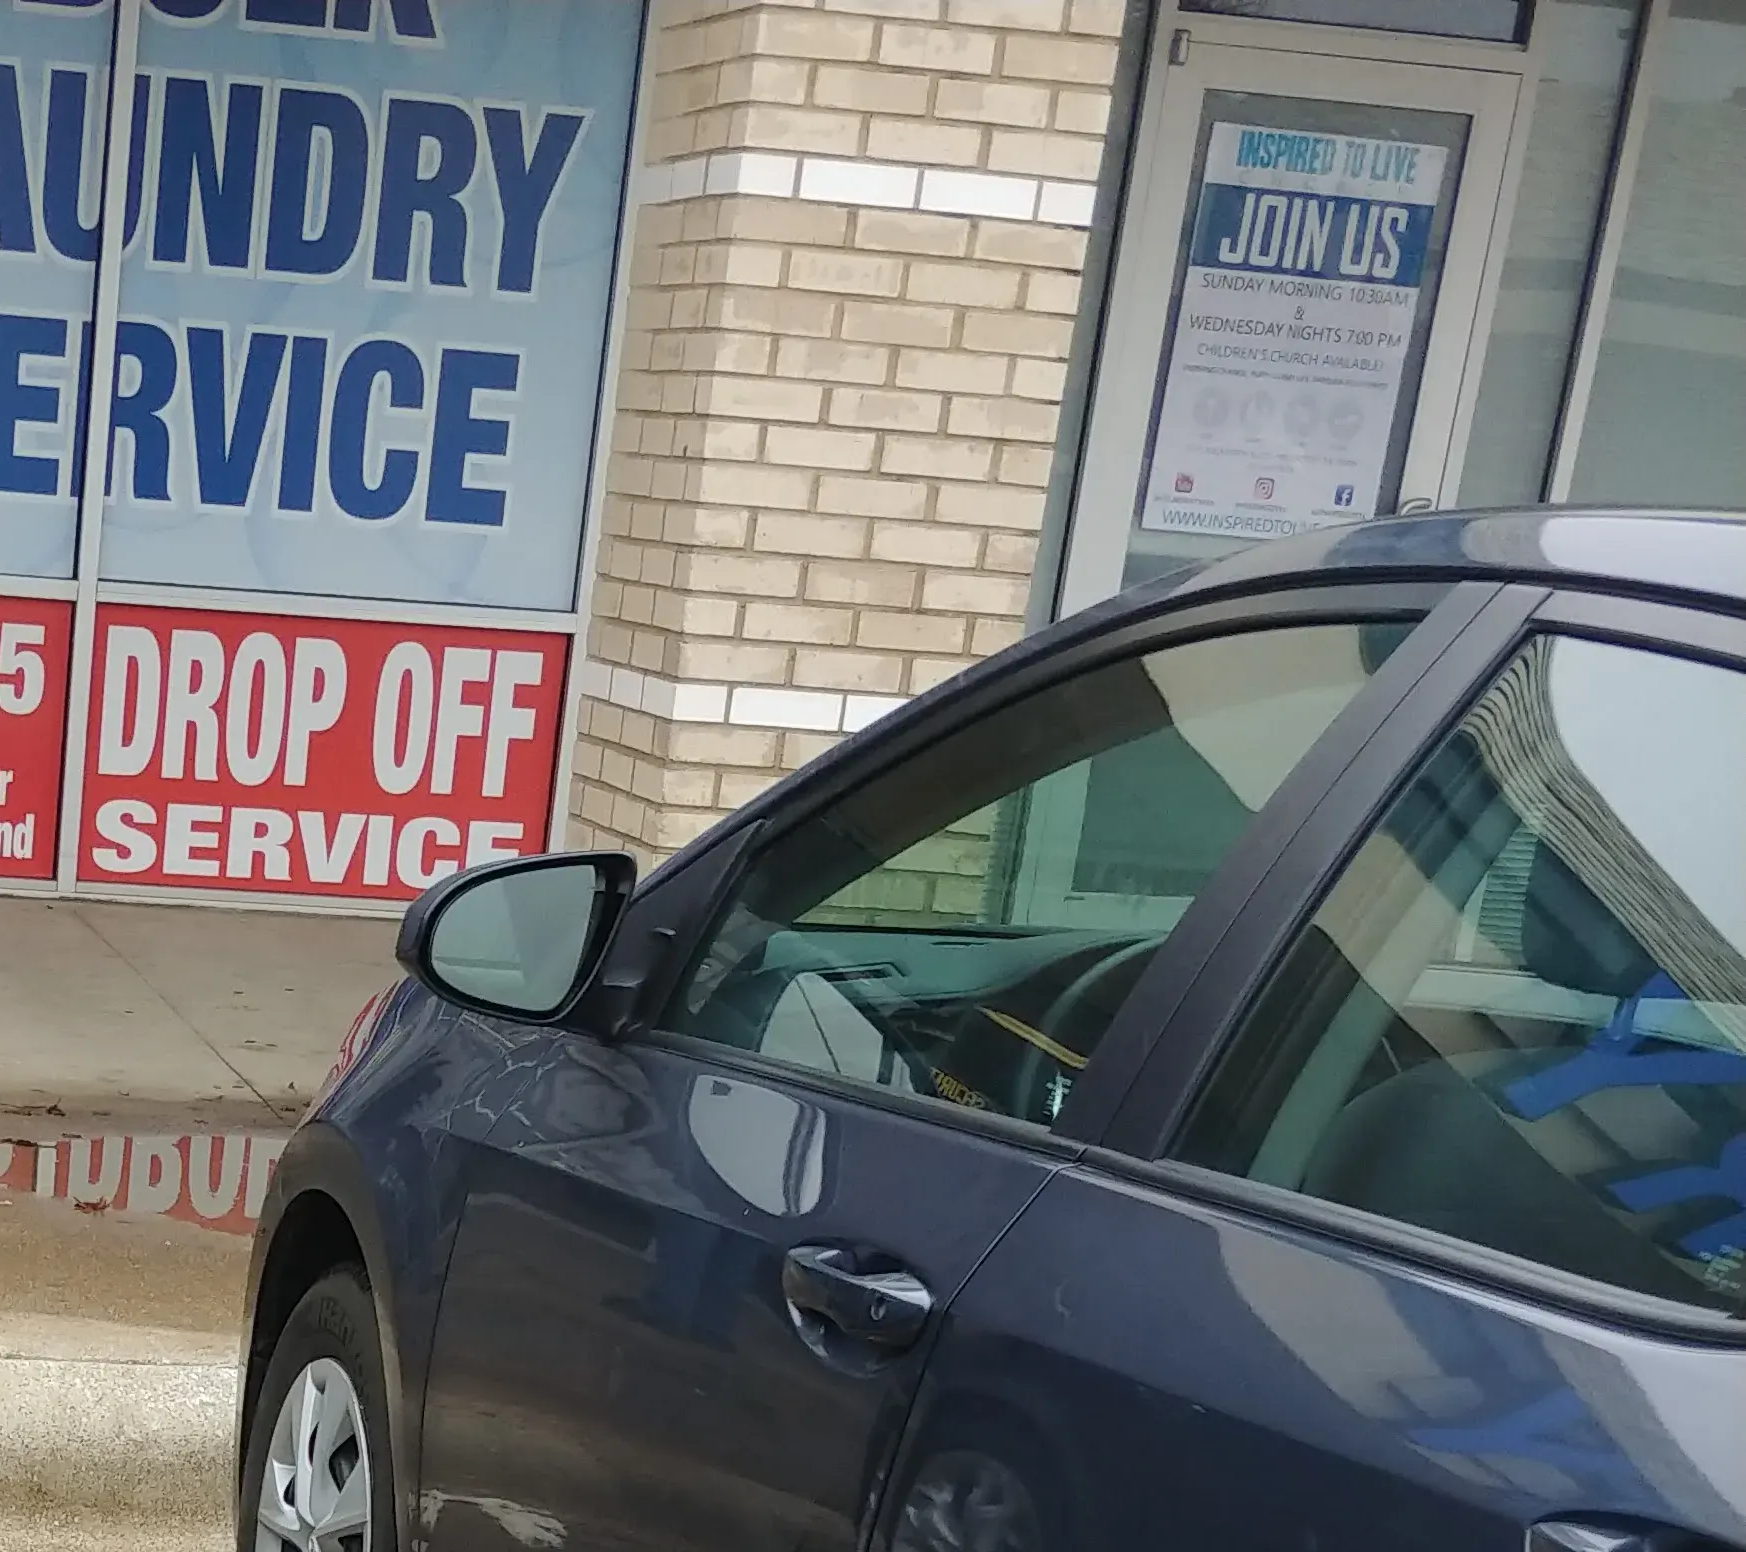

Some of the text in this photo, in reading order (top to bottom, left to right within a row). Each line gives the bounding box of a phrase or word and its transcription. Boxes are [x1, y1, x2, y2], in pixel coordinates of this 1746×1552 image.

[1236, 130, 1337, 175] INSPIRED
[1343, 142, 1367, 178] TO
[1370, 144, 1420, 184] LIVE
[1218, 193, 1409, 279] JOIN US
[1202, 273, 1265, 292] SUNDAY
[1268, 280, 1343, 300] MORNING
[1190, 314, 1285, 337] WEDNESDAY
[1288, 325, 1342, 343] NIGHTS
[1377, 333, 1403, 347] PM
[98, 625, 543, 797] DROP OFF
